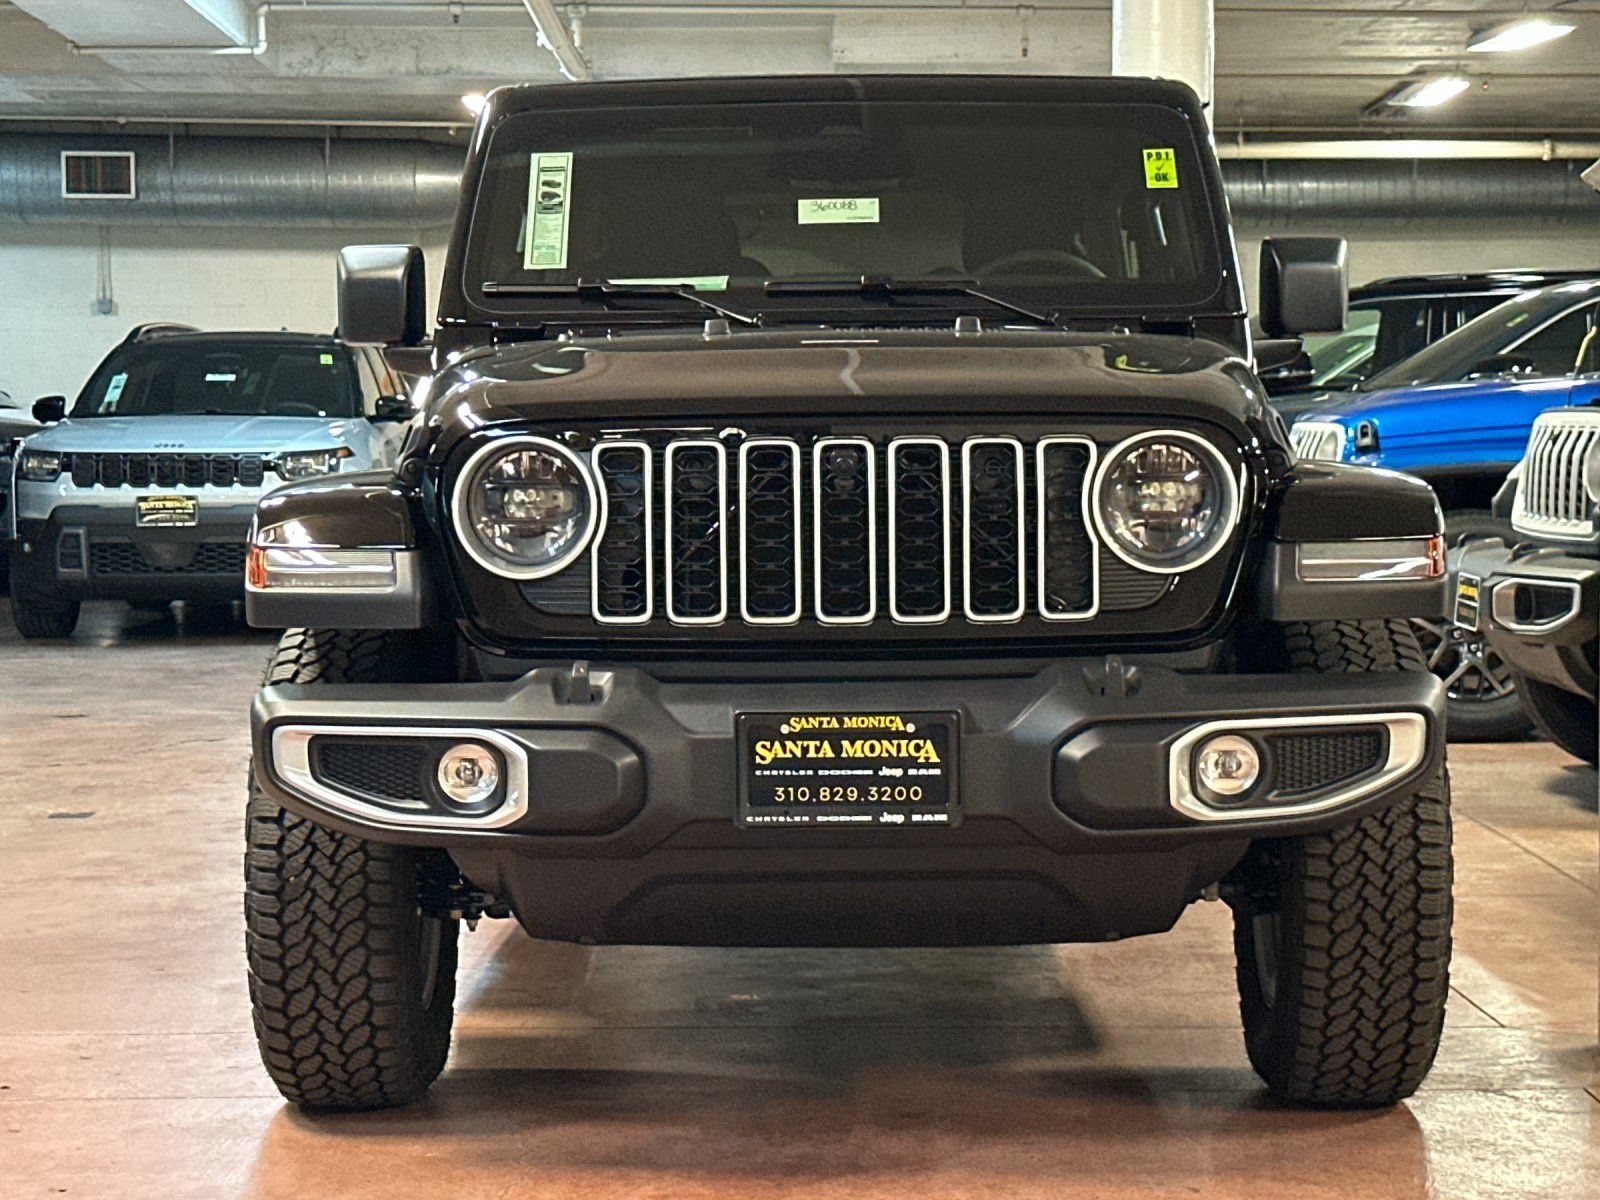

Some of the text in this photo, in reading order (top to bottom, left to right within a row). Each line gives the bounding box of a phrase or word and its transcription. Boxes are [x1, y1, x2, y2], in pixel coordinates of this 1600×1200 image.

[1155, 172, 1169, 182] OK
[789, 716, 905, 732] SANTA MONICA
[755, 739, 940, 764] SANTA MONICA
[878, 766, 904, 778] Jeep
[774, 786, 923, 802] 310.829.3200
[879, 812, 905, 824] Jeep
